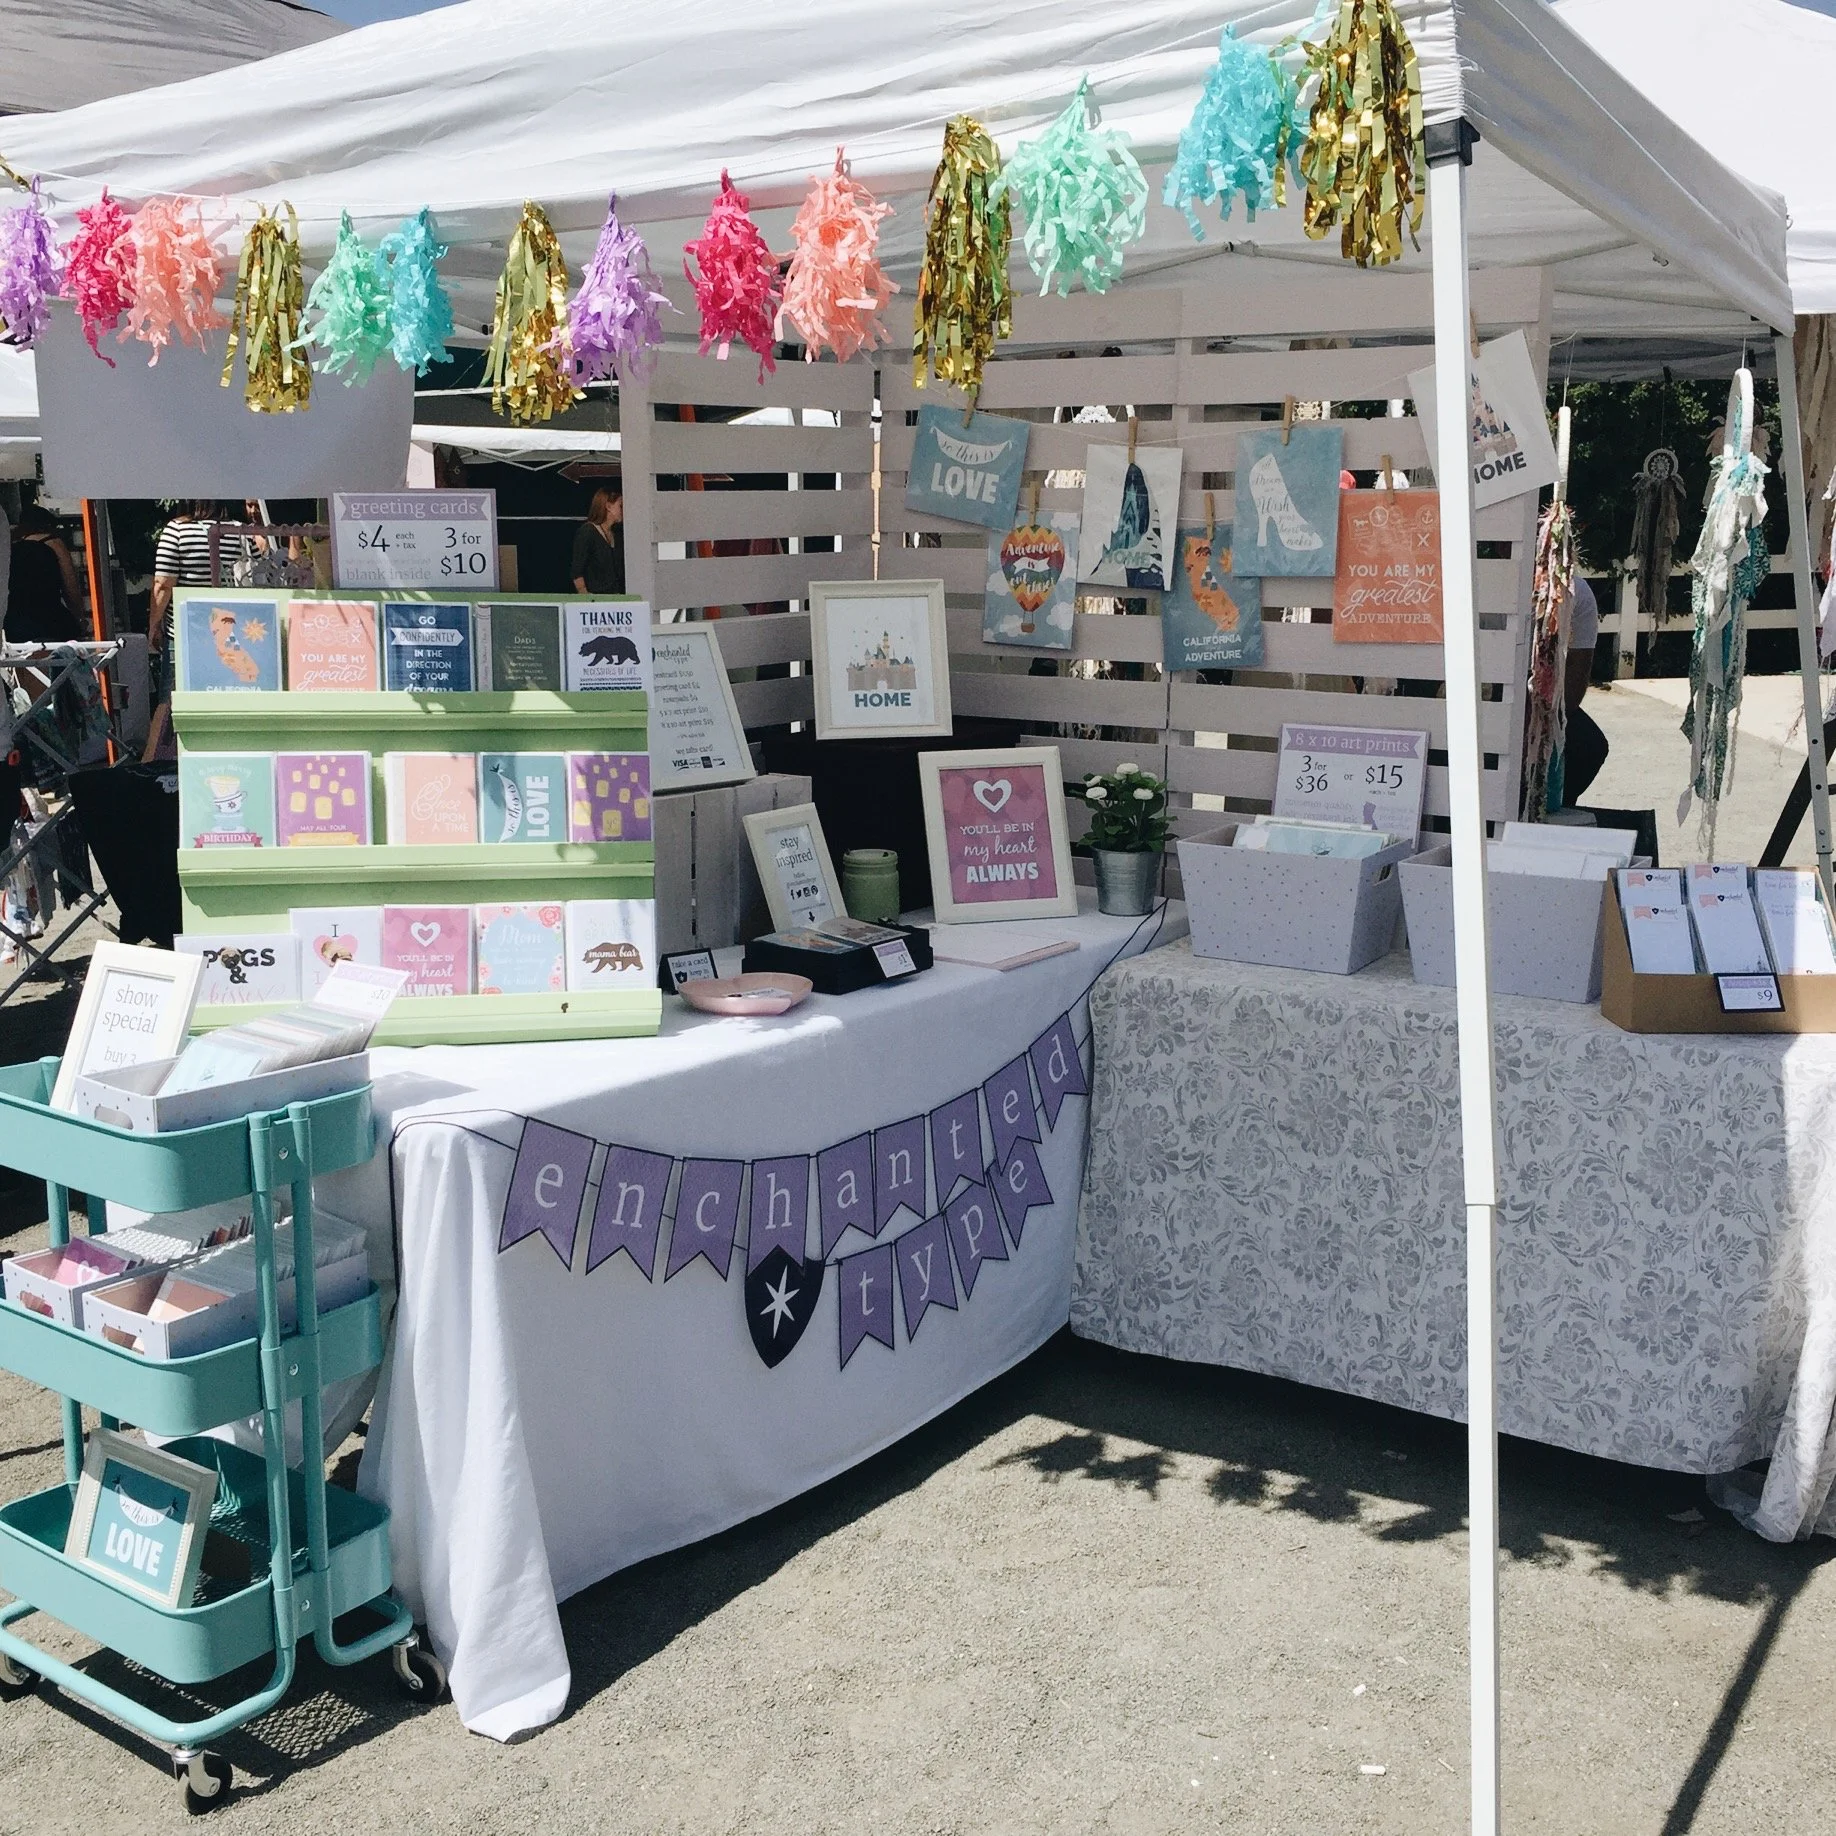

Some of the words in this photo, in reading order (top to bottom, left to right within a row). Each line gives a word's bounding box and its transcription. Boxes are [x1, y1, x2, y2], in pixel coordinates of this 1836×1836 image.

[931, 462, 1000, 504] LOVE
[350, 499, 426, 519] greeting
[430, 498, 478, 515] cards
[358, 525, 391, 552] $4
[395, 531, 415, 541] each
[404, 541, 416, 549] tax
[444, 527, 457, 548] 3
[462, 532, 482, 545] for
[440, 552, 487, 576] $10
[1103, 549, 1151, 568] HOME
[346, 567, 385, 580] blank
[389, 567, 432, 580] inside
[1349, 565, 1378, 577] YOU
[1384, 564, 1409, 577] ARE
[1416, 564, 1435, 577] MY
[1341, 578, 1437, 618] greatest
[418, 615, 436, 625] GO
[580, 611, 633, 625] THANKS
[1348, 613, 1432, 624] ADVENTURE
[400, 632, 455, 642] CONFIDENTLY
[1183, 634, 1241, 647] CALIFORNIA
[300, 654, 324, 662] YOU
[328, 654, 348, 662] ARE
[351, 654, 366, 663] MY
[414, 650, 425, 658] IN
[427, 650, 443, 658] THE
[1185, 650, 1242, 662] ADVENTURE
[406, 660, 451, 669] DIRECTION
[296, 664, 367, 690] greatest
[409, 672, 422, 680] OF
[425, 672, 449, 680] YOUR
[855, 692, 912, 708] HOME
[1295, 733, 1304, 746] 8
[1308, 735, 1317, 743] x
[1321, 736, 1337, 747] 10
[1340, 737, 1361, 749] art
[1365, 737, 1410, 753] prints
[672, 759, 688, 768] VISA
[1301, 755, 1312, 772] 3
[1314, 762, 1327, 771] for
[1295, 773, 1328, 794] $36
[1343, 773, 1354, 781] or
[1365, 764, 1403, 789] $15
[526, 775, 549, 837] LOVE
[434, 813, 466, 822] UPON
[432, 823, 440, 832] A
[445, 823, 469, 832] TIME
[960, 825, 1000, 835] YOU'LL
[1004, 824, 1019, 833] BE
[1022, 822, 1034, 832] IN
[203, 834, 254, 843] BIRTHDAY
[780, 836, 800, 850] stay
[964, 845, 990, 863] my
[994, 835, 1038, 855] heart
[775, 848, 814, 868] inspired
[967, 862, 1039, 884] ALWAYS
[332, 924, 339, 937] I
[500, 925, 543, 946] Mom
[203, 948, 275, 968] PGS
[589, 950, 617, 958] mama
[619, 945, 639, 957] bear
[693, 956, 709, 966] card
[230, 967, 248, 984] &
[421, 963, 454, 977] heart
[115, 984, 159, 1008] show
[398, 984, 453, 997] ALWAYS
[1757, 989, 1773, 1002] $9
[102, 1011, 158, 1034] special
[104, 1046, 127, 1067] buy
[534, 1034, 1069, 1233] enchanted
[859, 1160, 1028, 1316] type
[105, 1522, 164, 1577] LOVE
